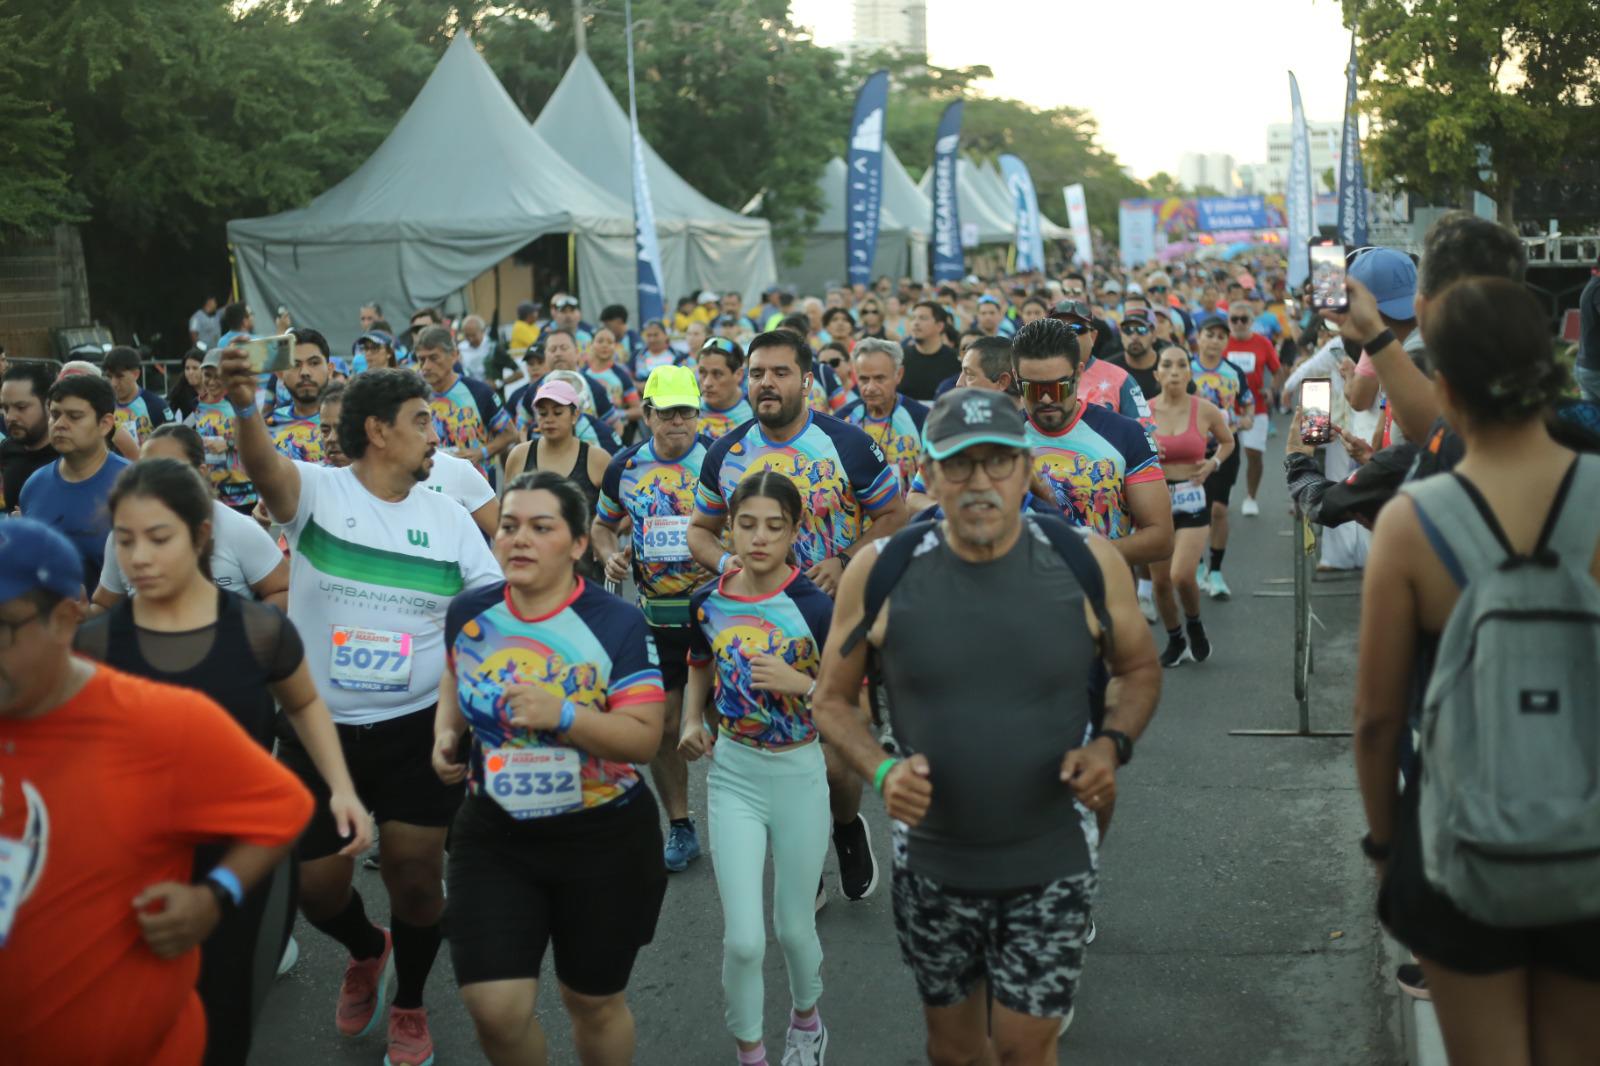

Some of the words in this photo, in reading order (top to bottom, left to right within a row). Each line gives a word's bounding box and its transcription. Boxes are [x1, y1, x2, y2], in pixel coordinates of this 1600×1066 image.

[936, 156, 952, 258] ARCANGEL
[319, 580, 437, 610] URBANIANOS
[335, 646, 407, 672] 5077
[493, 770, 576, 797] 6332
